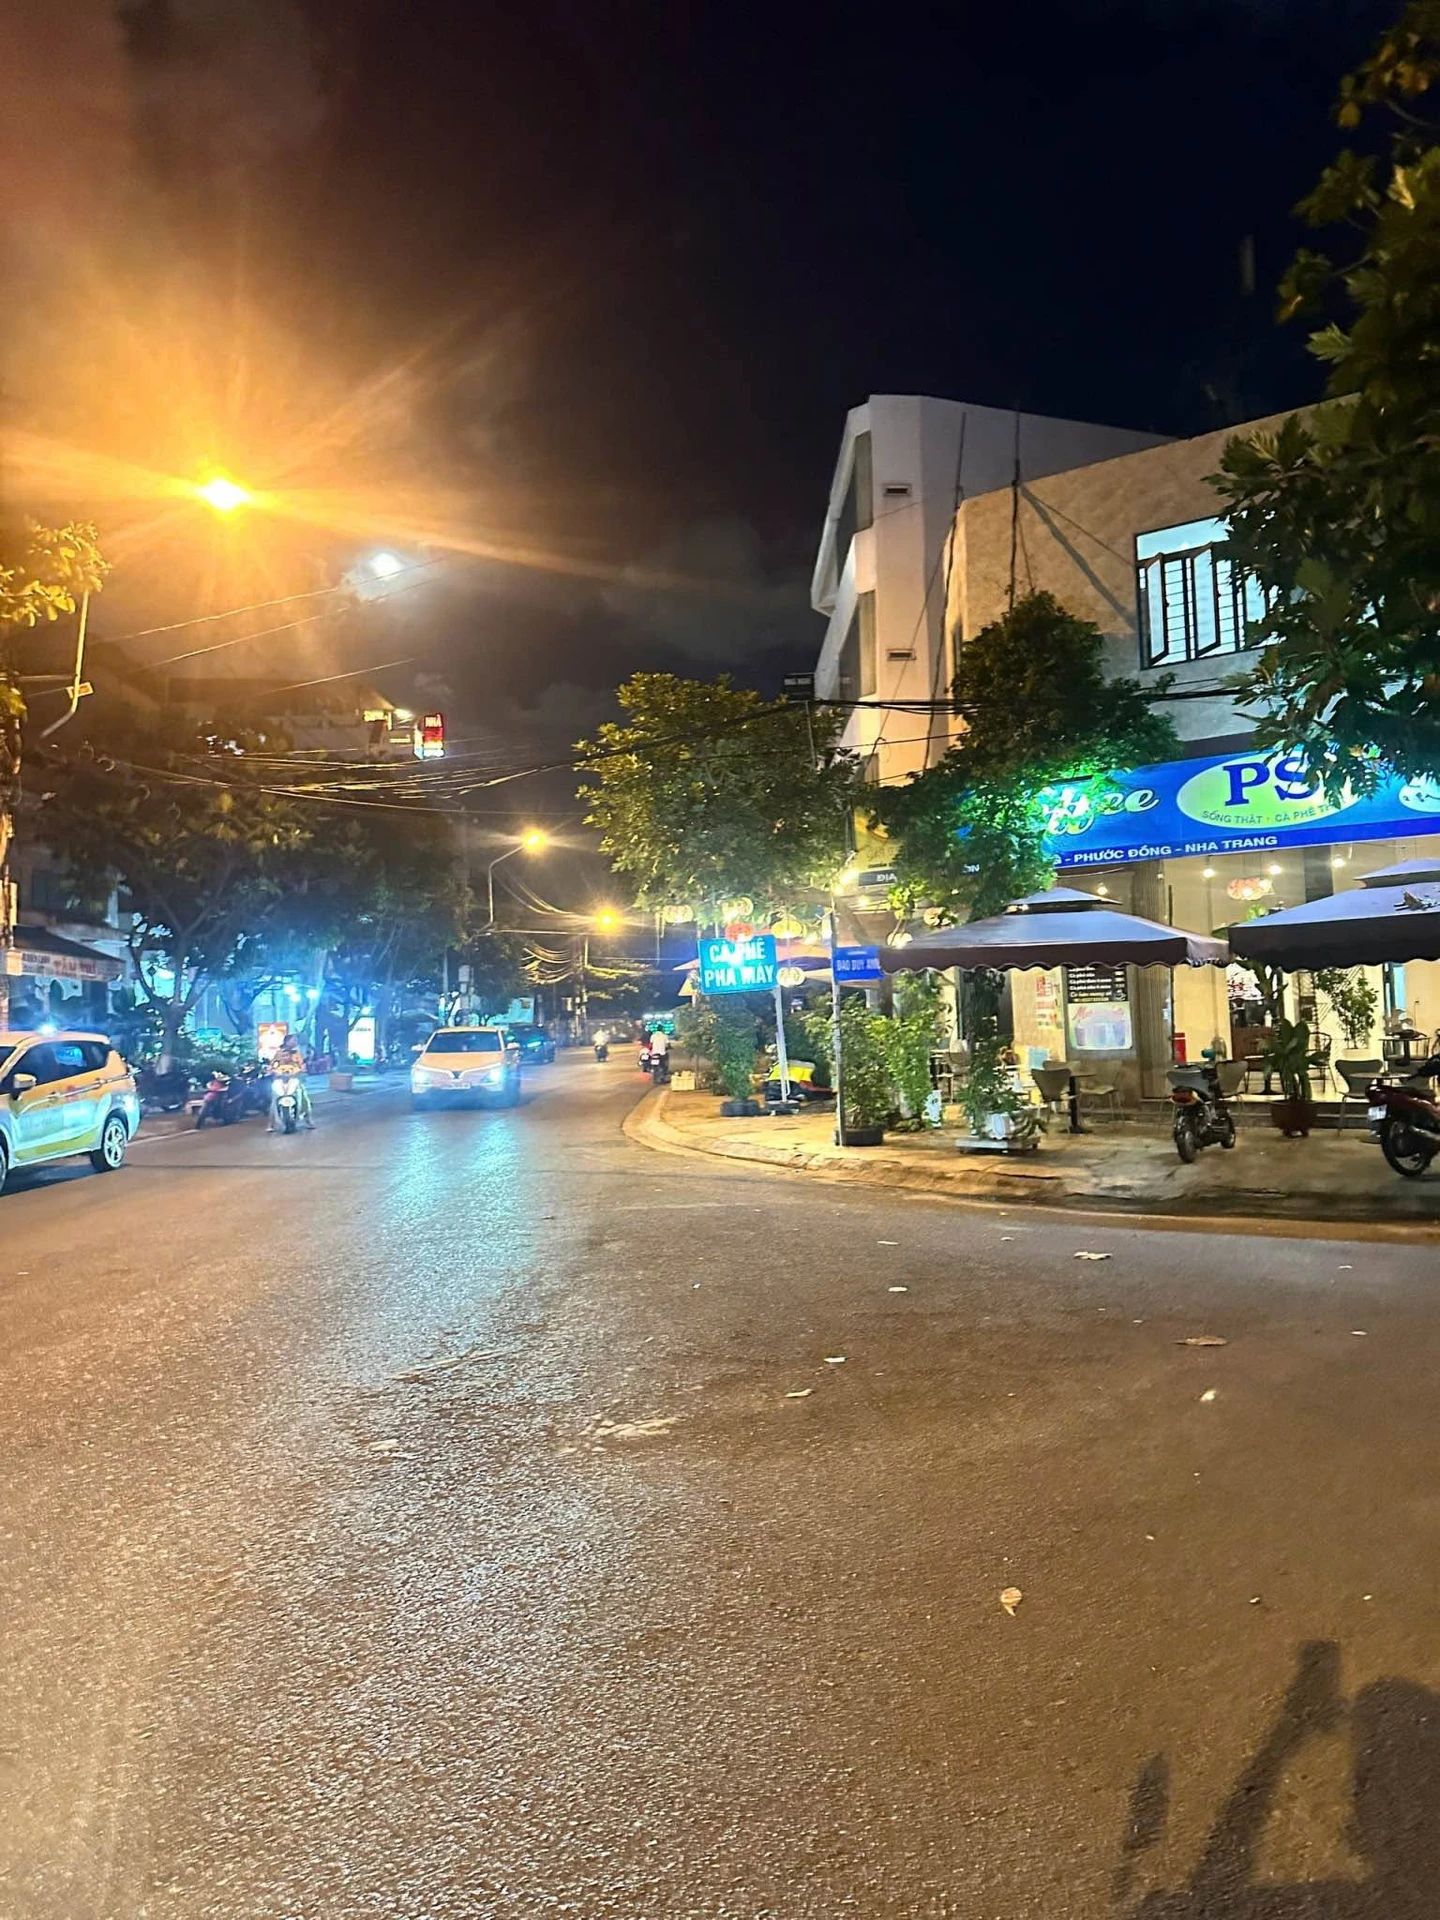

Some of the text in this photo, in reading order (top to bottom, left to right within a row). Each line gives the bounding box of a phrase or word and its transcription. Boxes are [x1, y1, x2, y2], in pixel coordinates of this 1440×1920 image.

[1222, 756, 1320, 806] PS
[1185, 841, 1218, 853] NHA
[1221, 836, 1278, 849] TRANG
[704, 966, 737, 988] PHA
